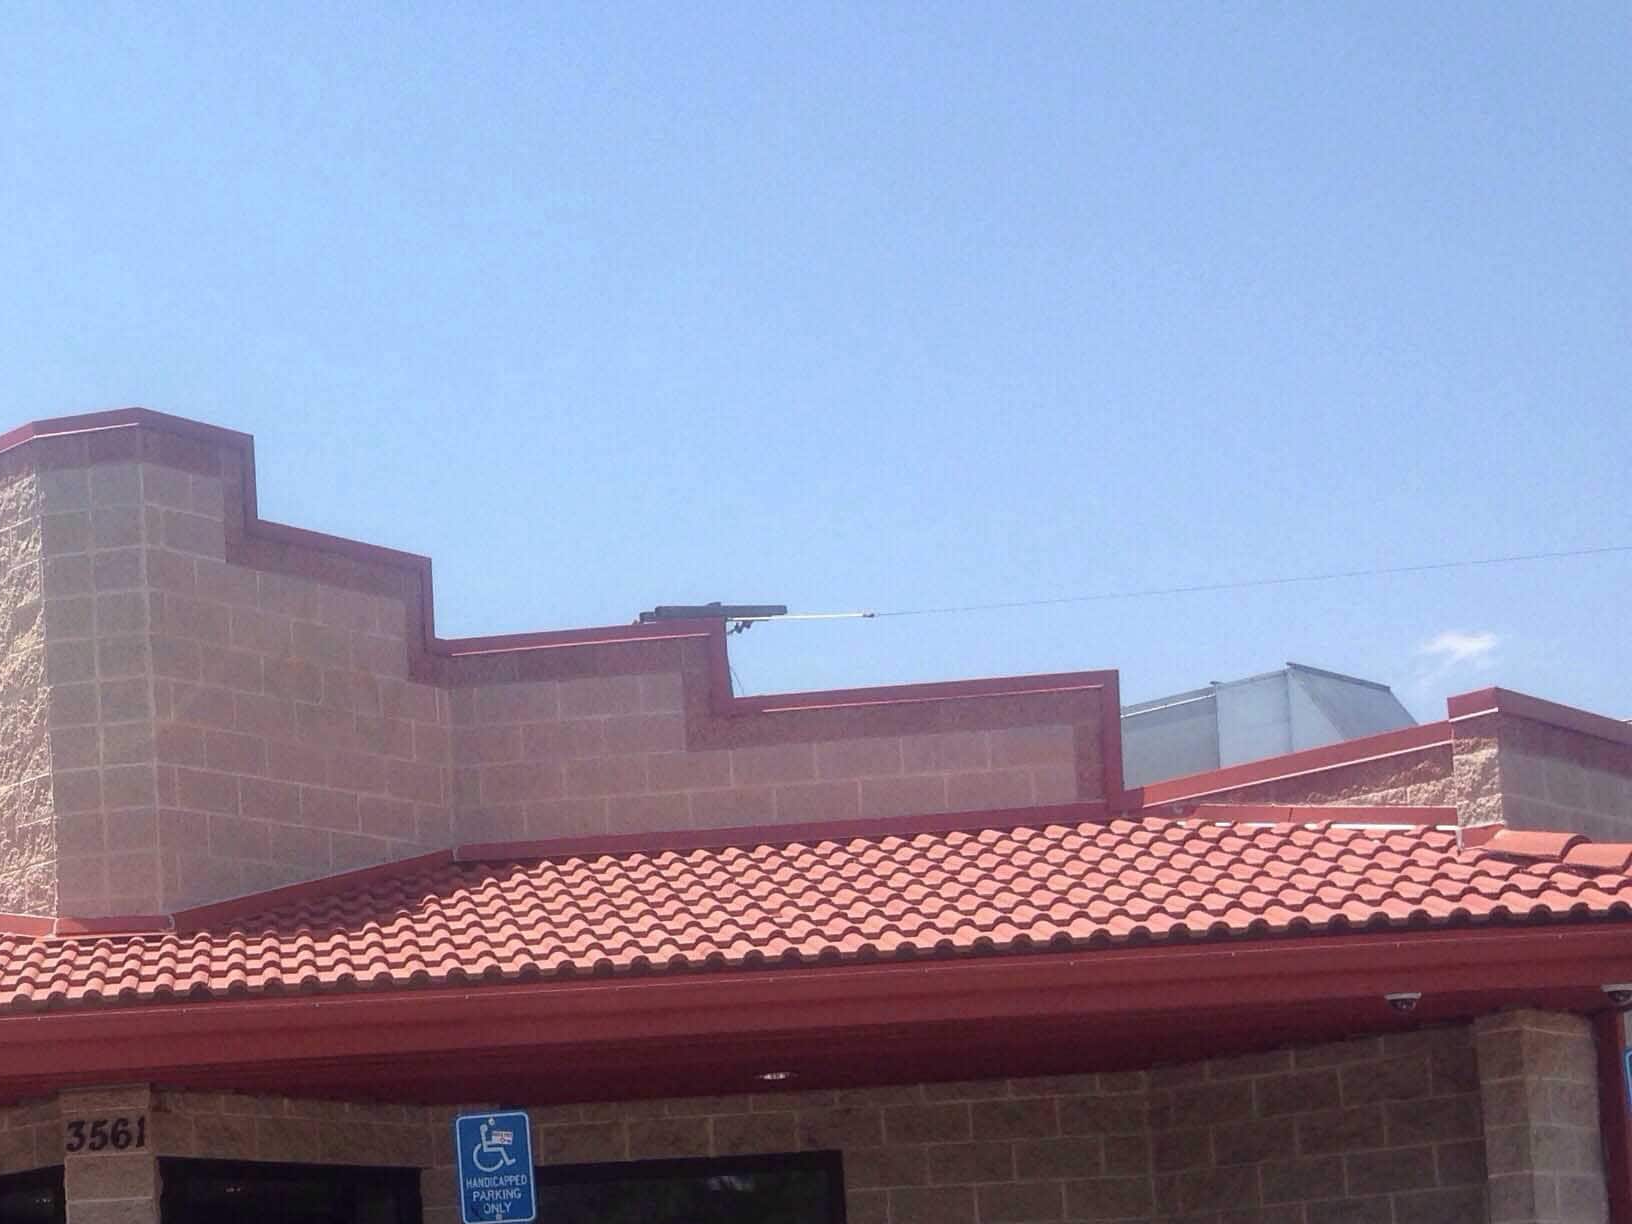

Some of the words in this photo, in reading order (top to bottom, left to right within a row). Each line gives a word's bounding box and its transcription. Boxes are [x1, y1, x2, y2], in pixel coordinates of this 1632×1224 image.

[65, 1115, 145, 1152] 3561
[466, 1175, 528, 1189] HANDICAPPED
[472, 1188, 521, 1202] PARKING
[483, 1202, 512, 1215] ONLY
